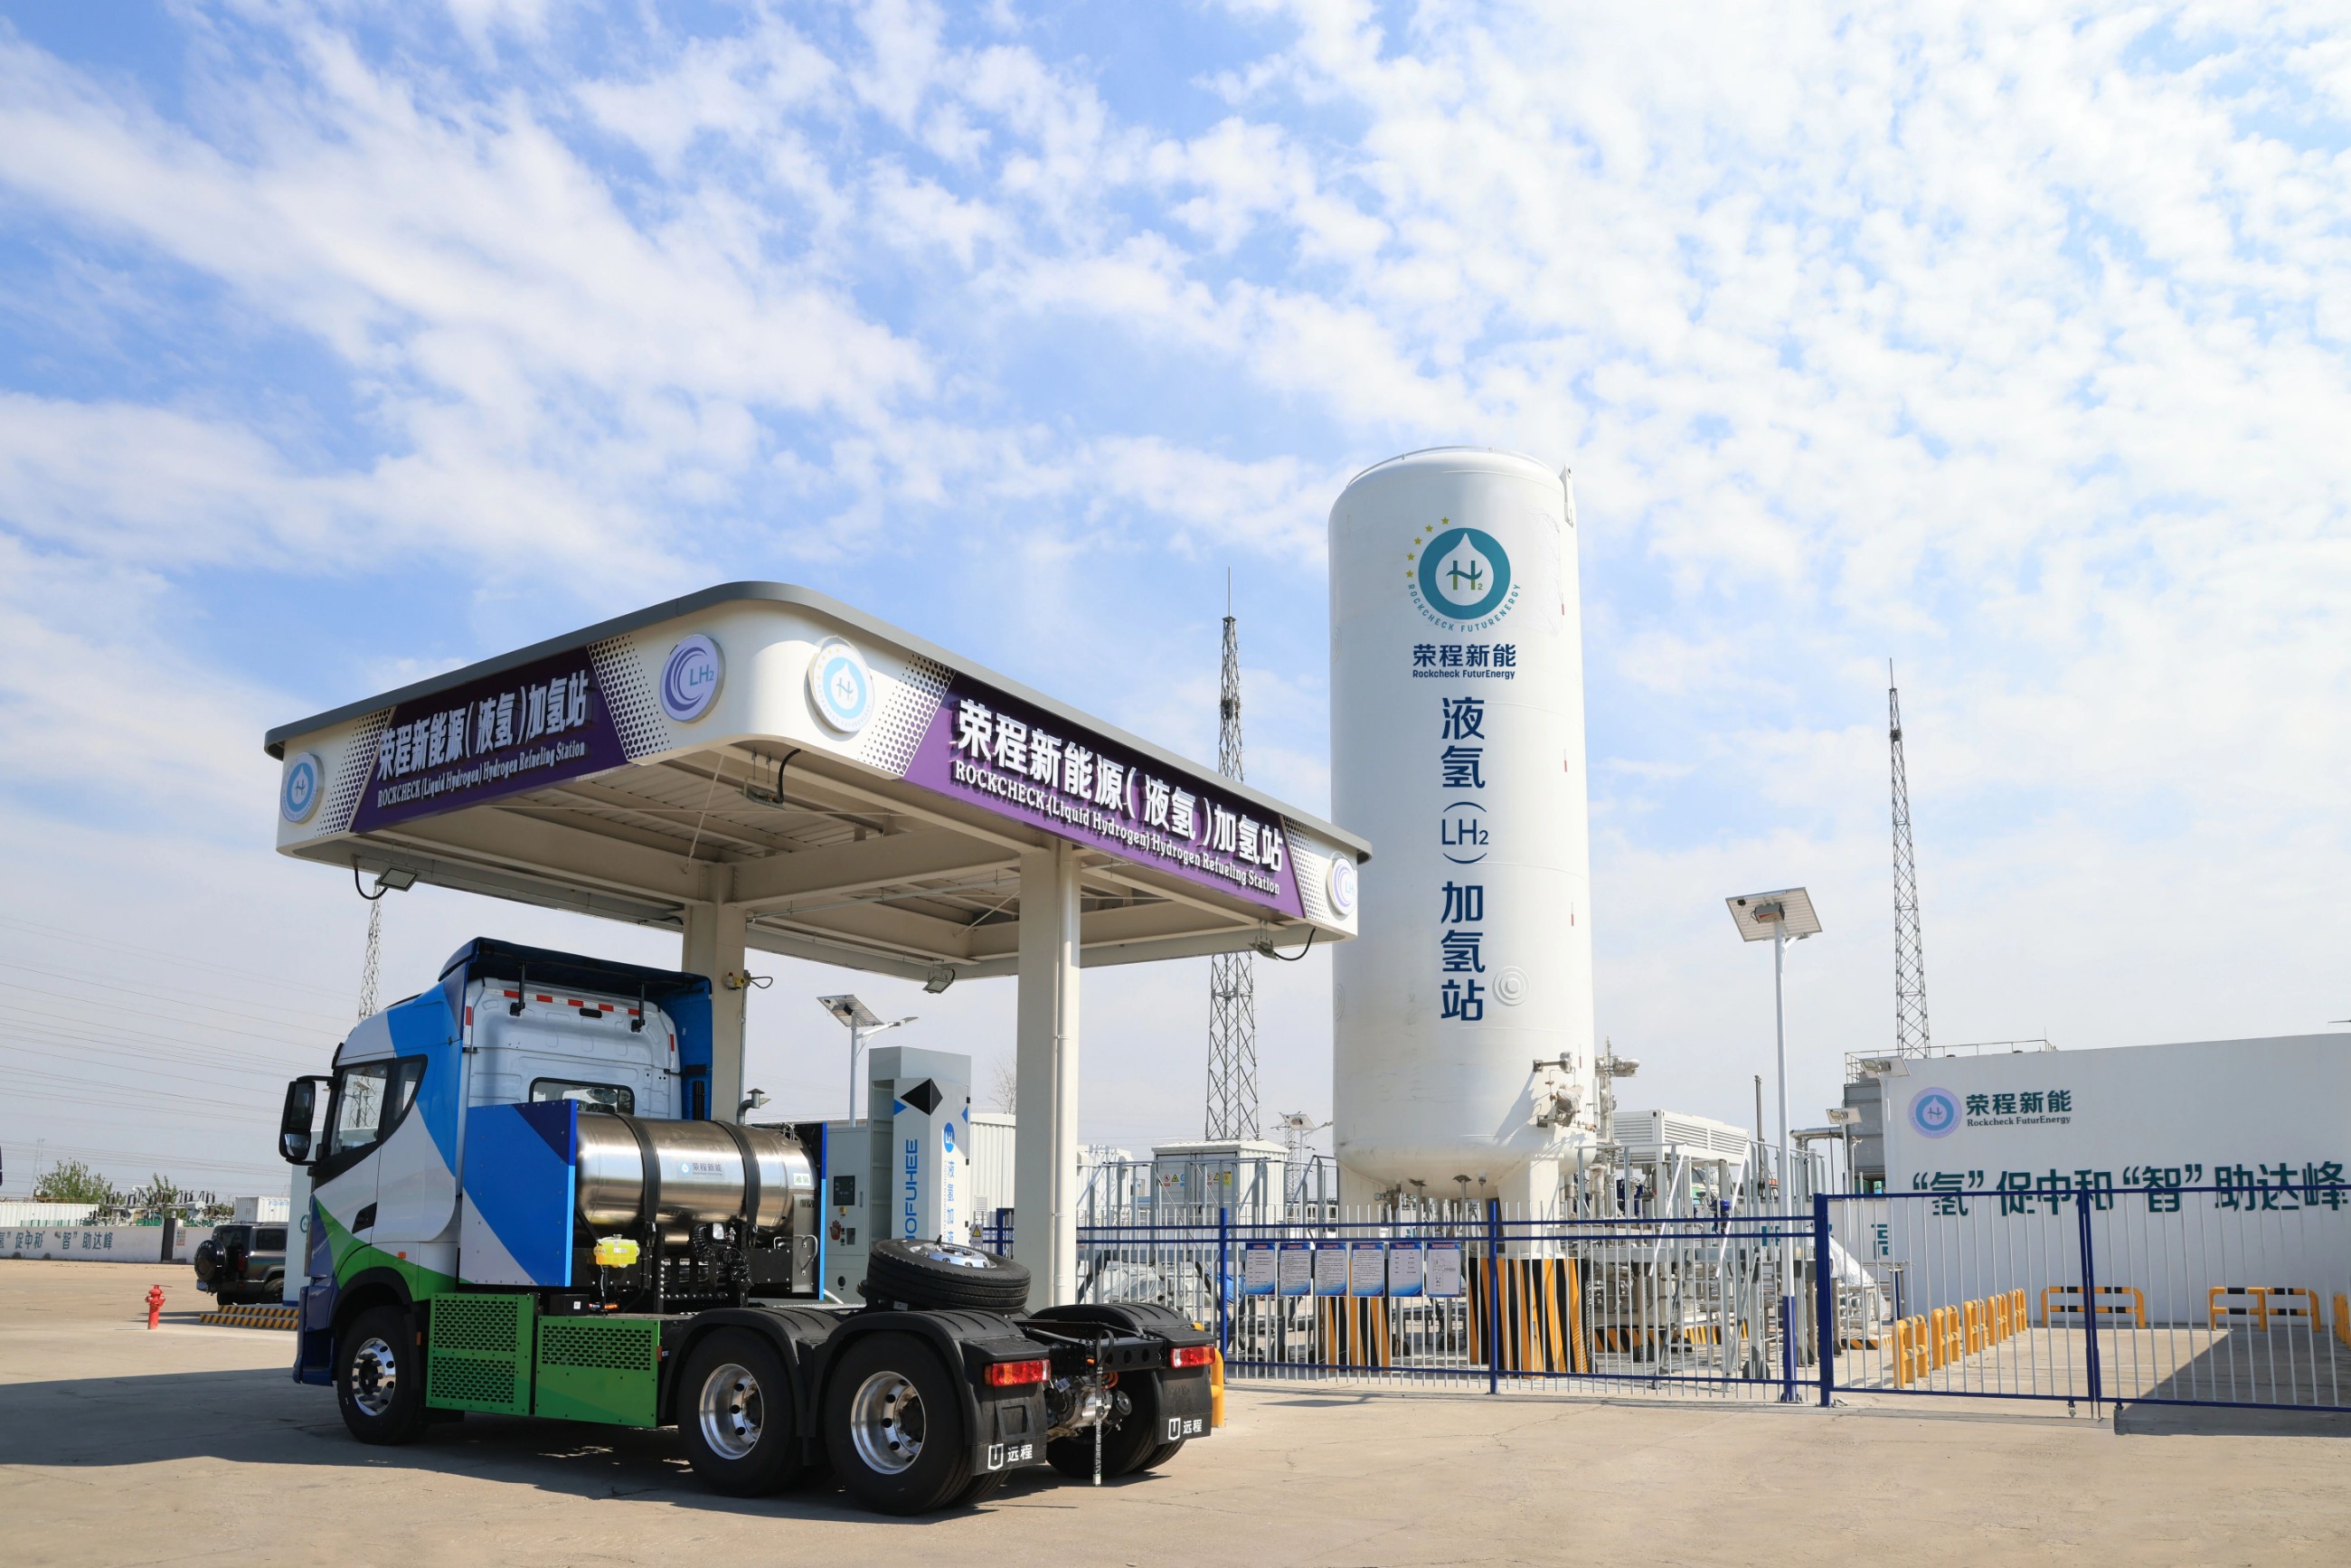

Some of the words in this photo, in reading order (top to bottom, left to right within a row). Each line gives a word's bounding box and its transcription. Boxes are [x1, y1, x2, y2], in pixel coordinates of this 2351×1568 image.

[1408, 583, 1454, 631] ROCKCHECK
[1460, 584, 1521, 632] FUTURENERGY
[1412, 643, 1516, 667] 荣程新能
[1412, 669, 1459, 678] Rockcheck
[1462, 669, 1515, 680] FuturEnergy
[483, 757, 518, 783] Hydrogen
[519, 746, 555, 771] Refueling
[555, 740, 586, 761] Station
[955, 760, 1046, 811] ROCKCHECK
[1152, 833, 1202, 867] Hydrogen
[1202, 851, 1247, 886] Refueling
[1248, 870, 1281, 895] Station
[1966, 1090, 2072, 1117] 荣程新能
[1967, 1117, 2015, 1127] Rockcheck
[2016, 1115, 2072, 1125] FuturEnergy
[904, 1138, 919, 1240] OFUHEE
[1184, 1418, 1203, 1435] 远程
[1006, 1443, 1033, 1462] 远程
